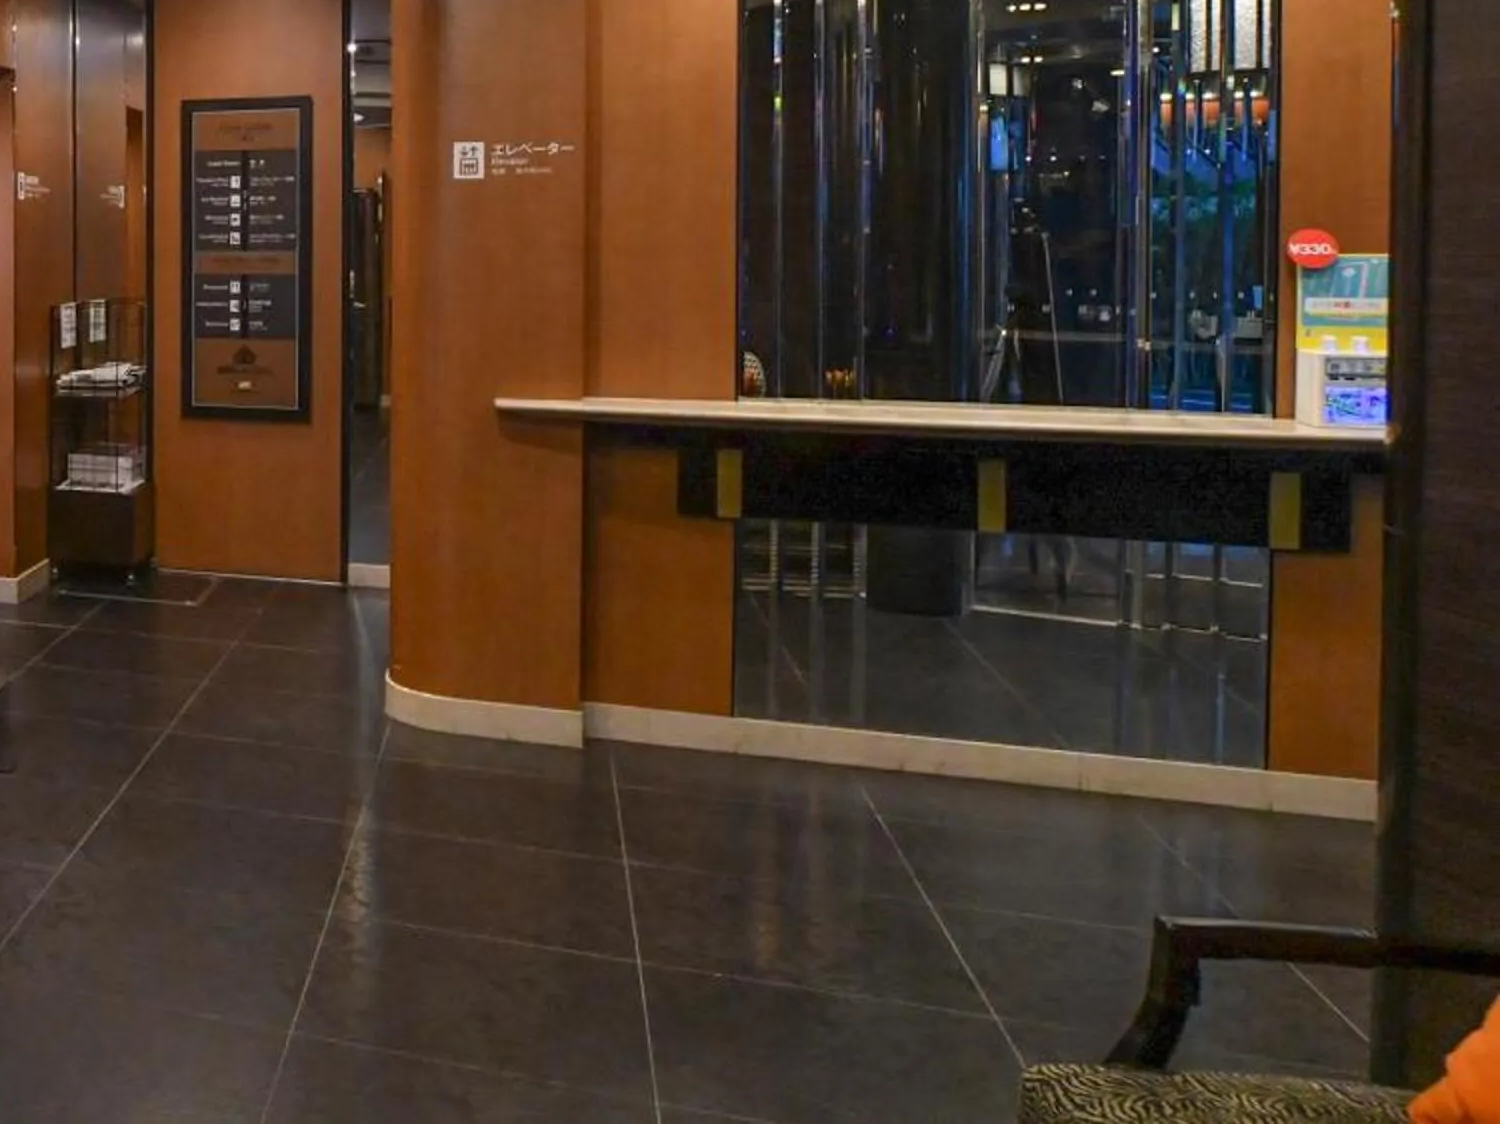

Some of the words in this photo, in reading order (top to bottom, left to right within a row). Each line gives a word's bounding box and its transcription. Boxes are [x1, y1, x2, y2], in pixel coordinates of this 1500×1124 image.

[491, 141, 575, 156] エレベーター
